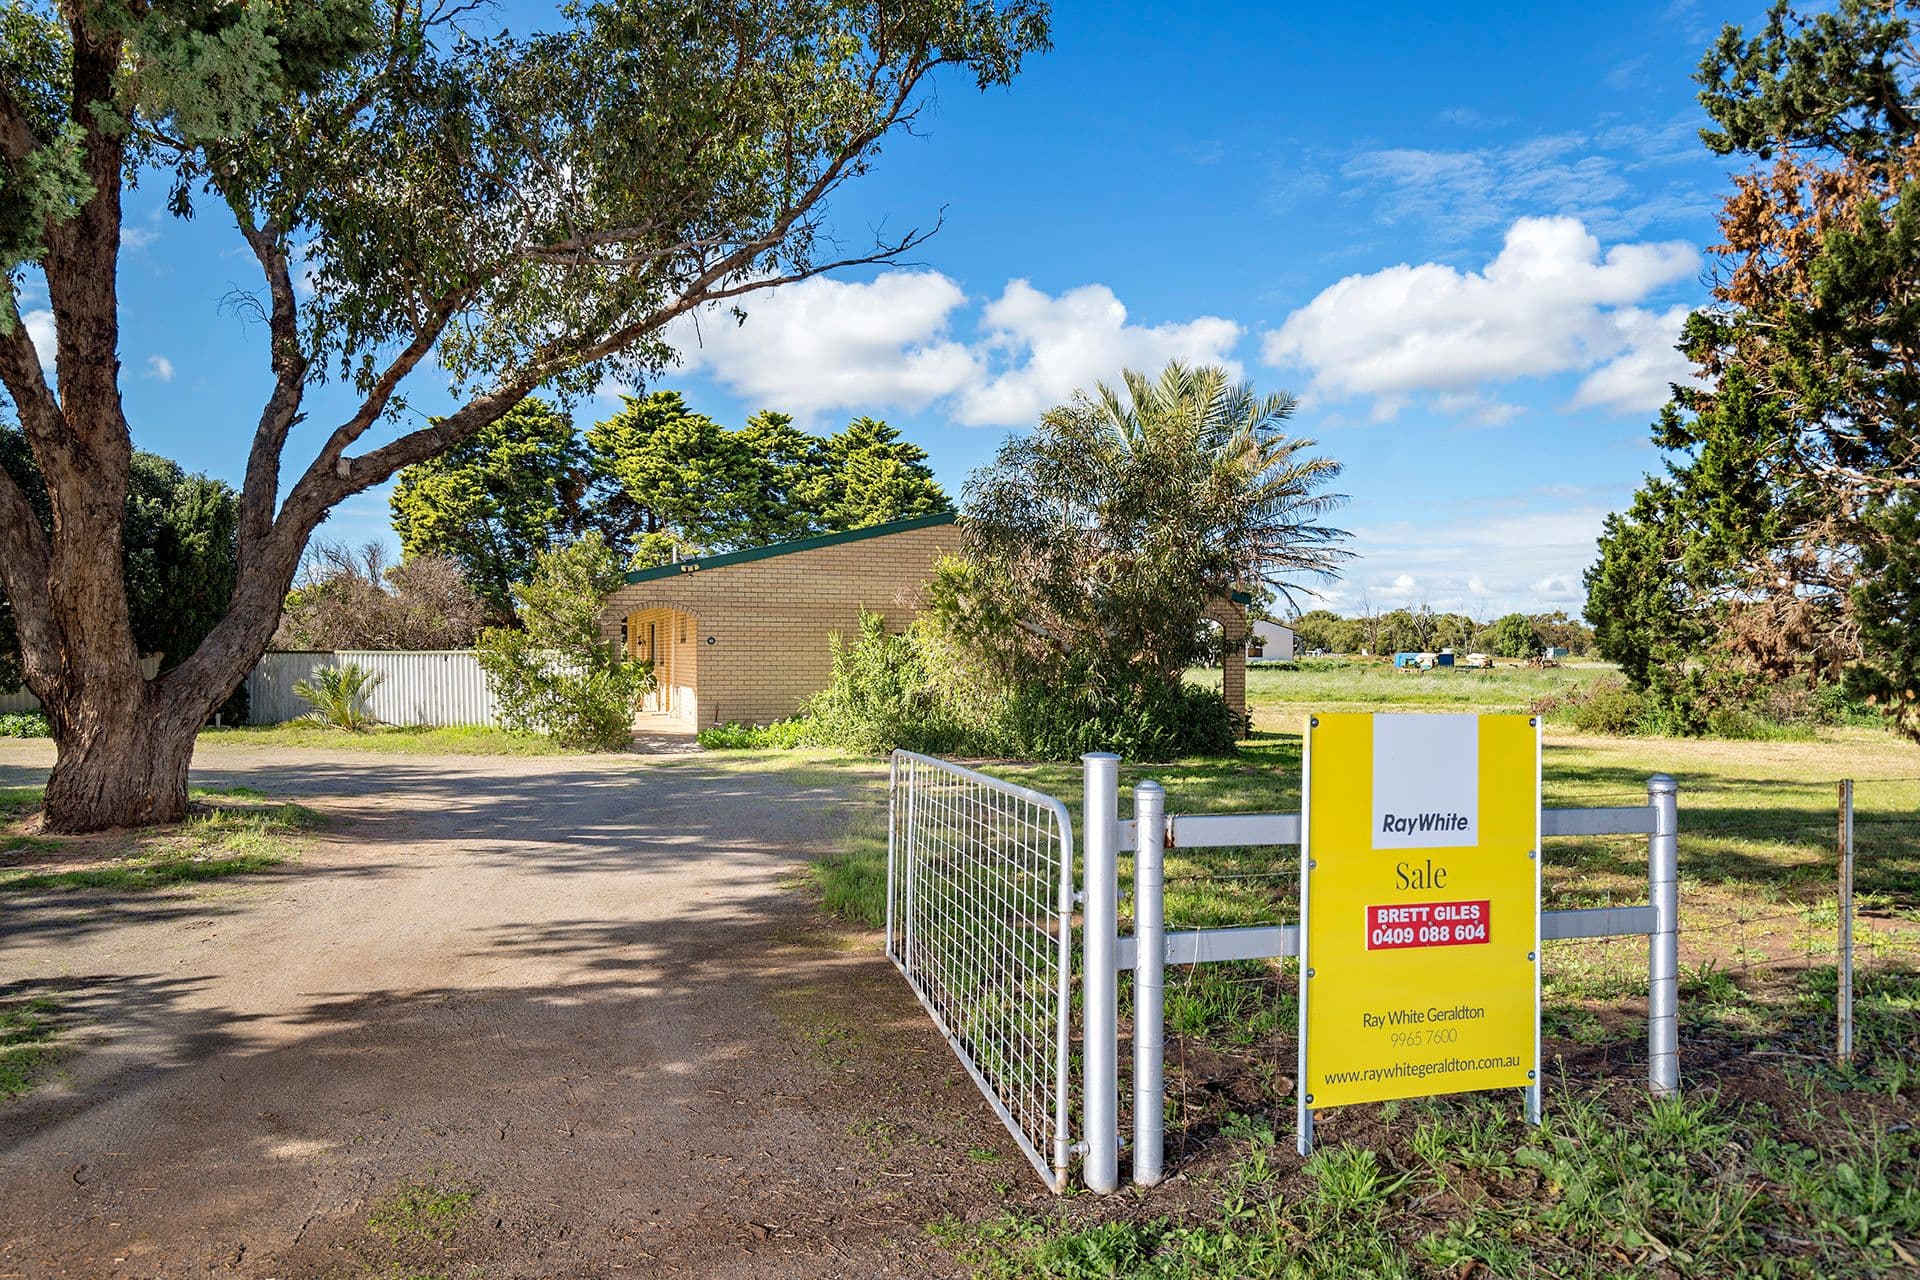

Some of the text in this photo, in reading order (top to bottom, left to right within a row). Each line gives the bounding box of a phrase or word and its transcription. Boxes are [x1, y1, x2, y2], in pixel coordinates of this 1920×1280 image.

[1396, 860, 1447, 890] Sale
[1378, 905, 1480, 924] BRETT GILES
[1372, 925, 1485, 945] 0409 088 604
[1363, 1005, 1485, 1029] Ray White Geraldton
[1391, 1028, 1457, 1048] 9965 7600
[1324, 1054, 1520, 1085] www.raywhitegeraldton.com.au
